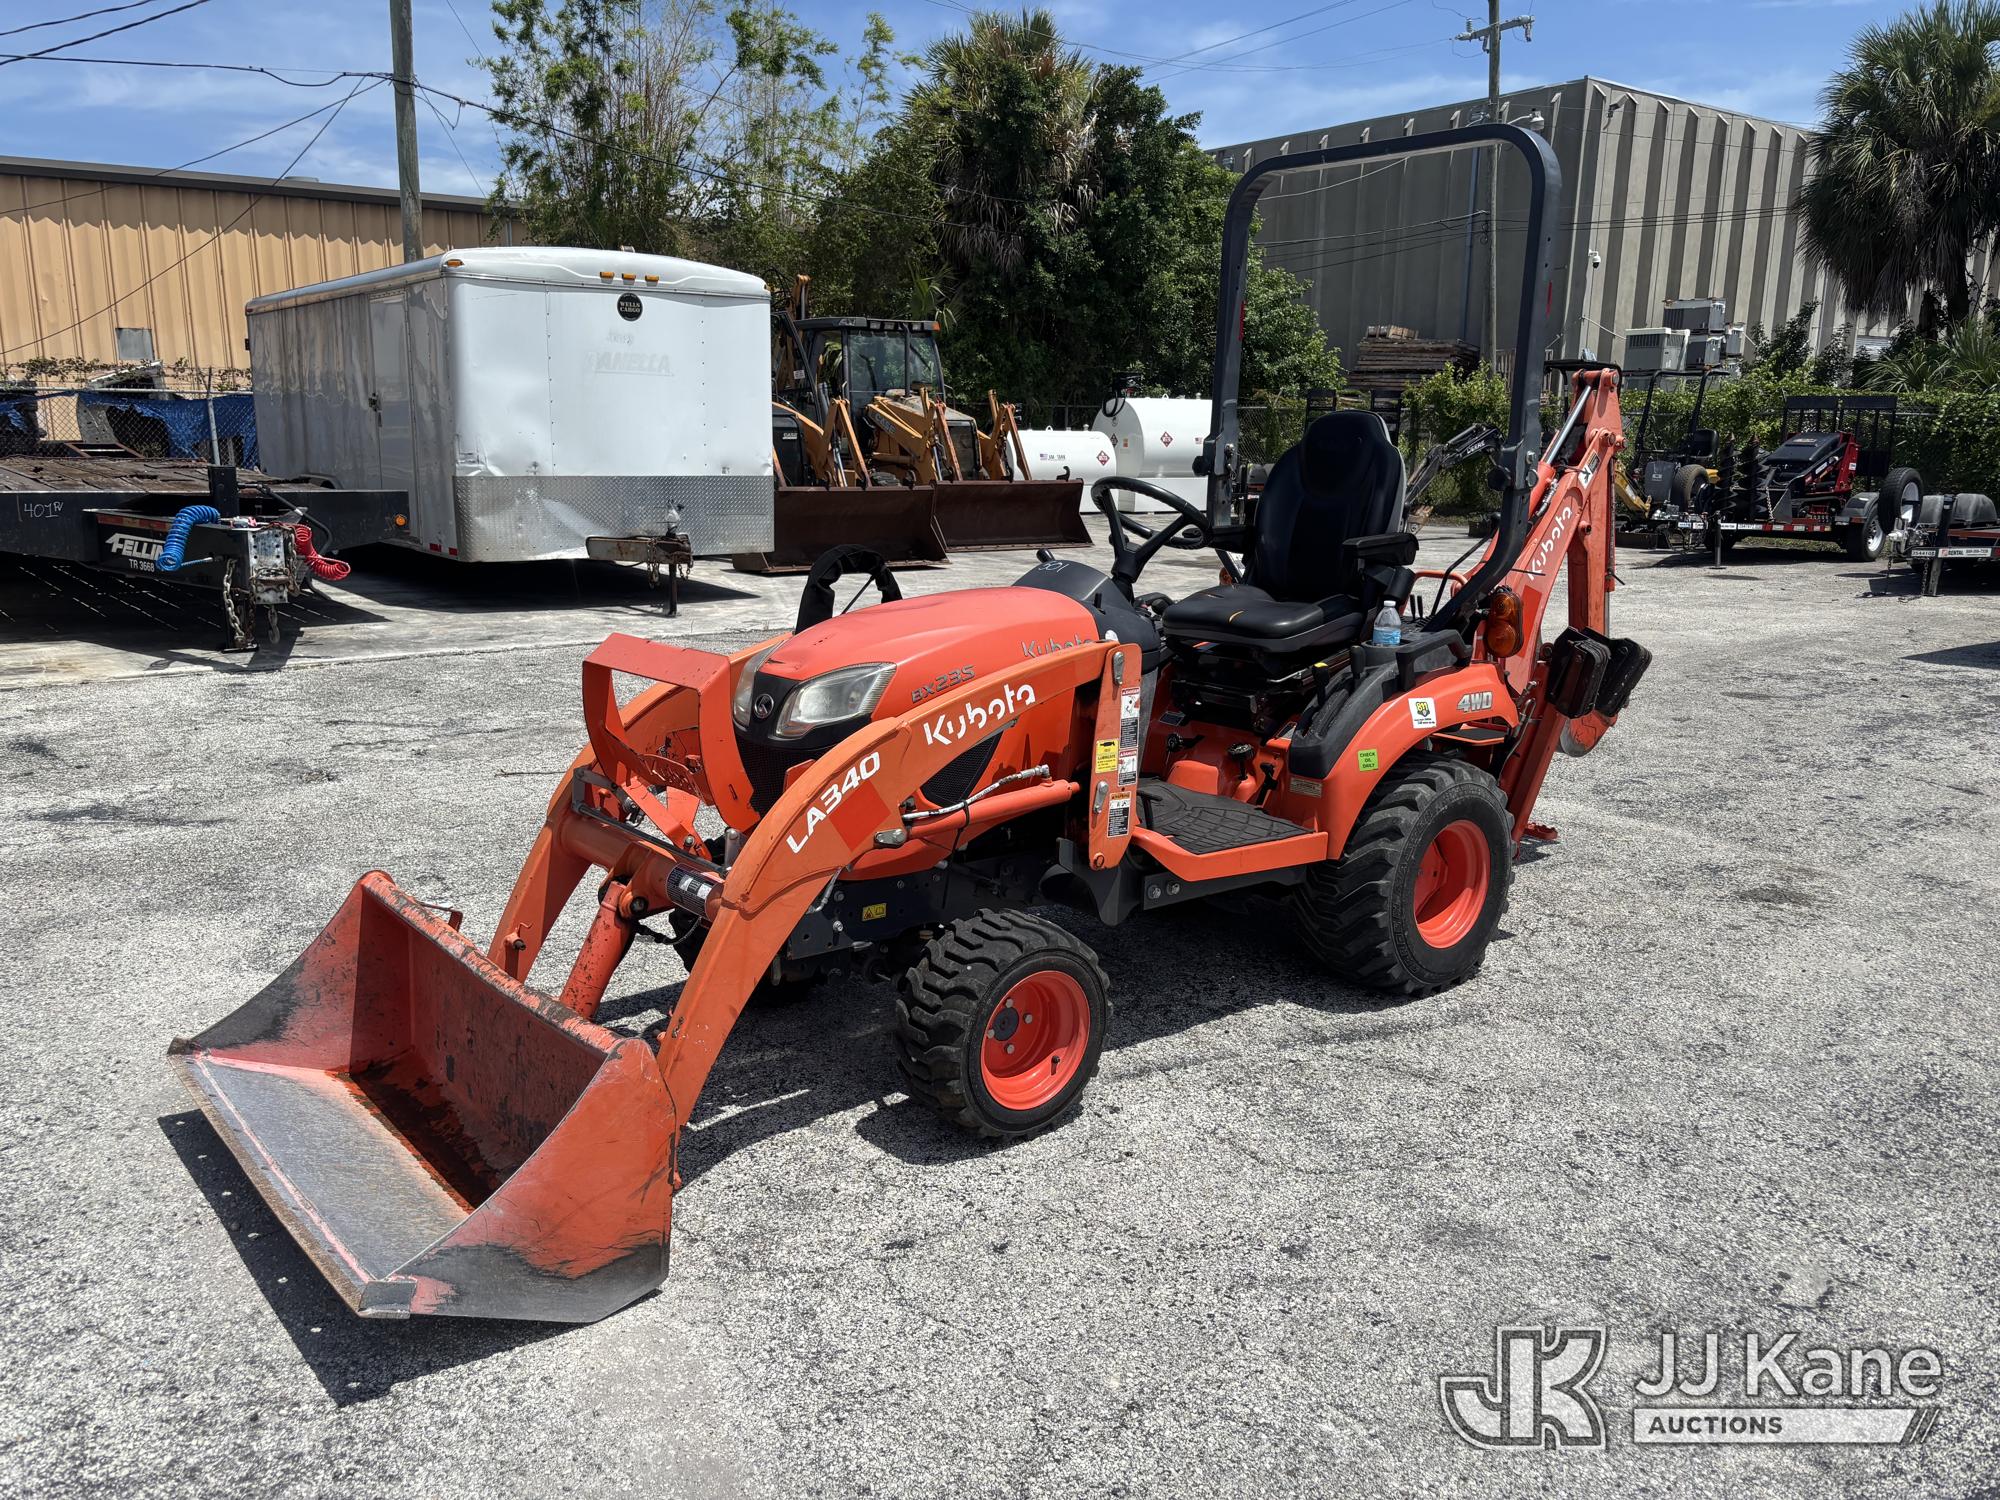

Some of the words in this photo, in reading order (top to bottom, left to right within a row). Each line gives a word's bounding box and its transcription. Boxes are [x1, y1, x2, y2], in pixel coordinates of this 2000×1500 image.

[24, 502, 59, 518] 401
[105, 532, 166, 562] FELLIN
[1527, 506, 1572, 580] Kubota
[128, 558, 139, 569] TR
[139, 560, 155, 573] 3668
[911, 664, 977, 704] BX23S
[923, 683, 1036, 746] Kubota
[1457, 691, 1493, 713] 4WD
[786, 751, 880, 854] LA340
